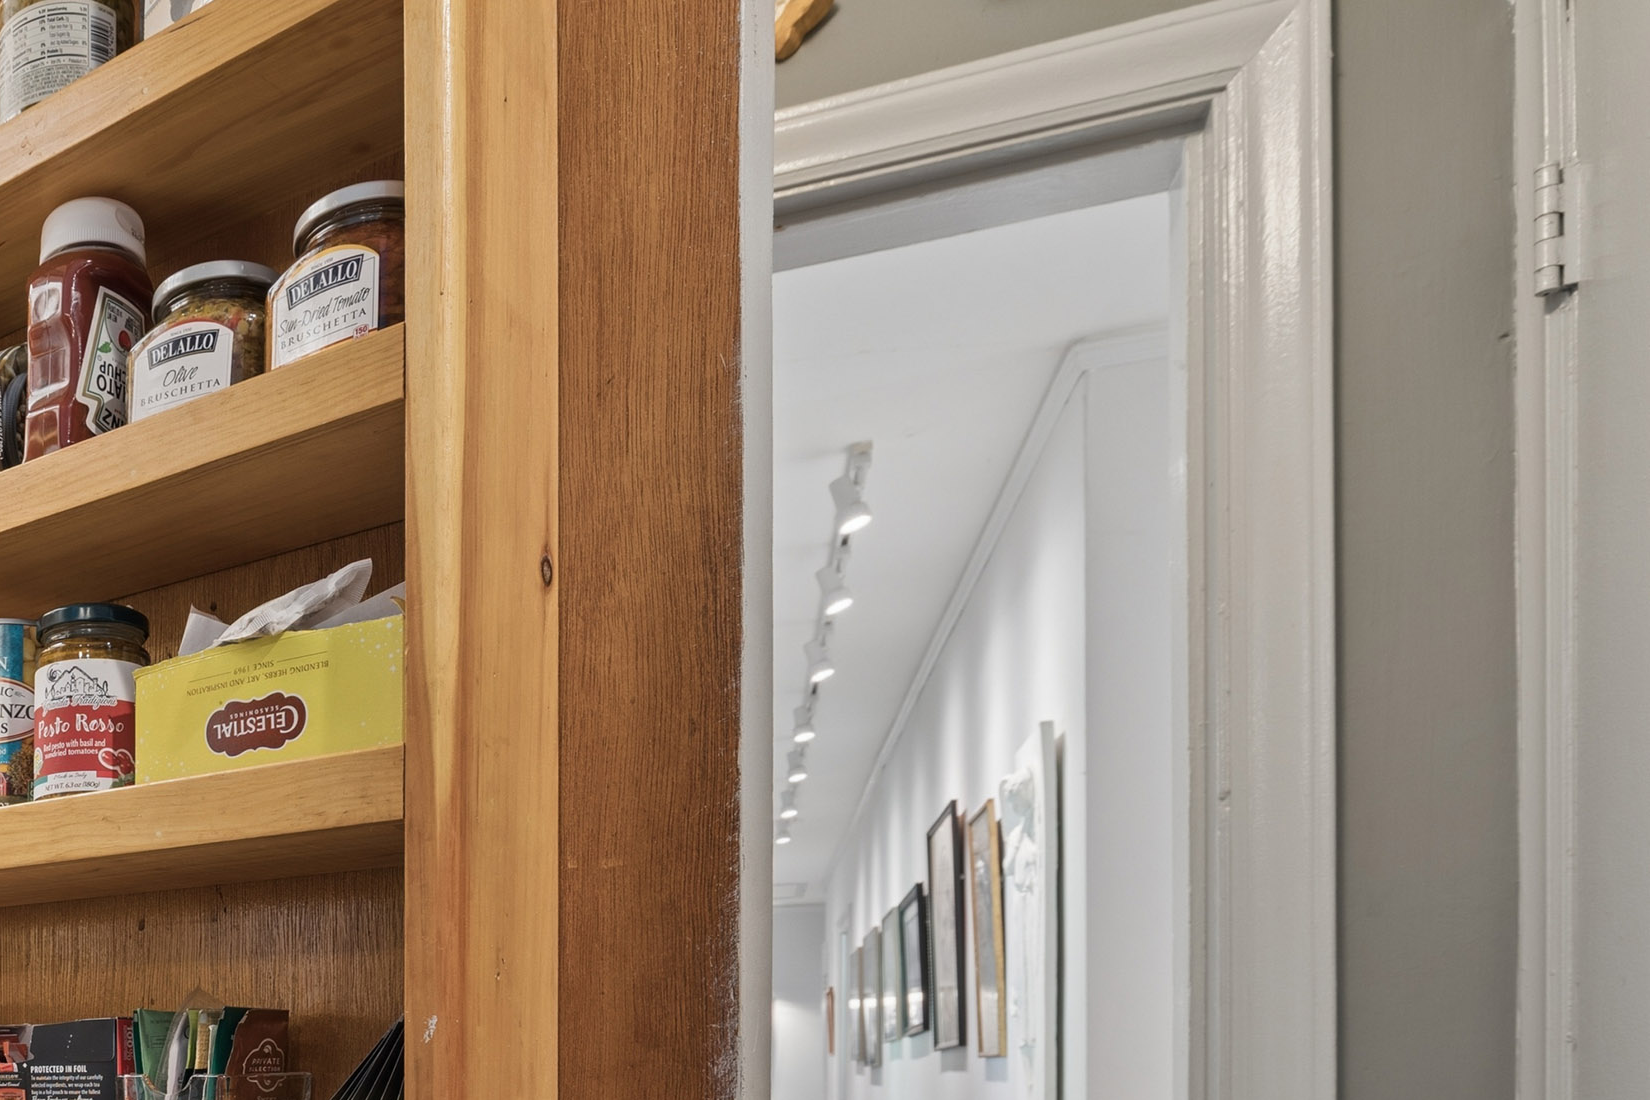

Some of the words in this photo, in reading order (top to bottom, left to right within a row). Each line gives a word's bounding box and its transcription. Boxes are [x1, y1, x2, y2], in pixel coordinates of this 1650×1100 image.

[289, 260, 358, 305] DELALLO
[278, 298, 333, 338] Sun-Dried
[333, 287, 372, 314] Tomato
[280, 308, 367, 350] BRUSCHETTA
[151, 333, 214, 365] DELALLO
[162, 366, 198, 387] Olive
[140, 379, 221, 407] BRUSCHETTA
[233, 666, 250, 675] 1969
[253, 660, 274, 669] SINCE
[289, 660, 329, 673] BLENDING
[230, 679, 244, 687] AND
[247, 675, 261, 683] ART
[186, 681, 228, 697] INSPIRATION
[230, 705, 279, 720] SEASONINGS
[38, 717, 70, 739] Pesto
[76, 714, 124, 733] Rosso
[213, 705, 299, 740] CELESTIAL
[51, 743, 65, 751] pesto
[94, 738, 106, 746] and
[68, 748, 98, 756] tomatoes
[252, 1057, 280, 1065] PRIVATE
[30, 1065, 65, 1073] PROTECTED
[65, 1065, 73, 1073] IN
[73, 1065, 88, 1073] FOIL
